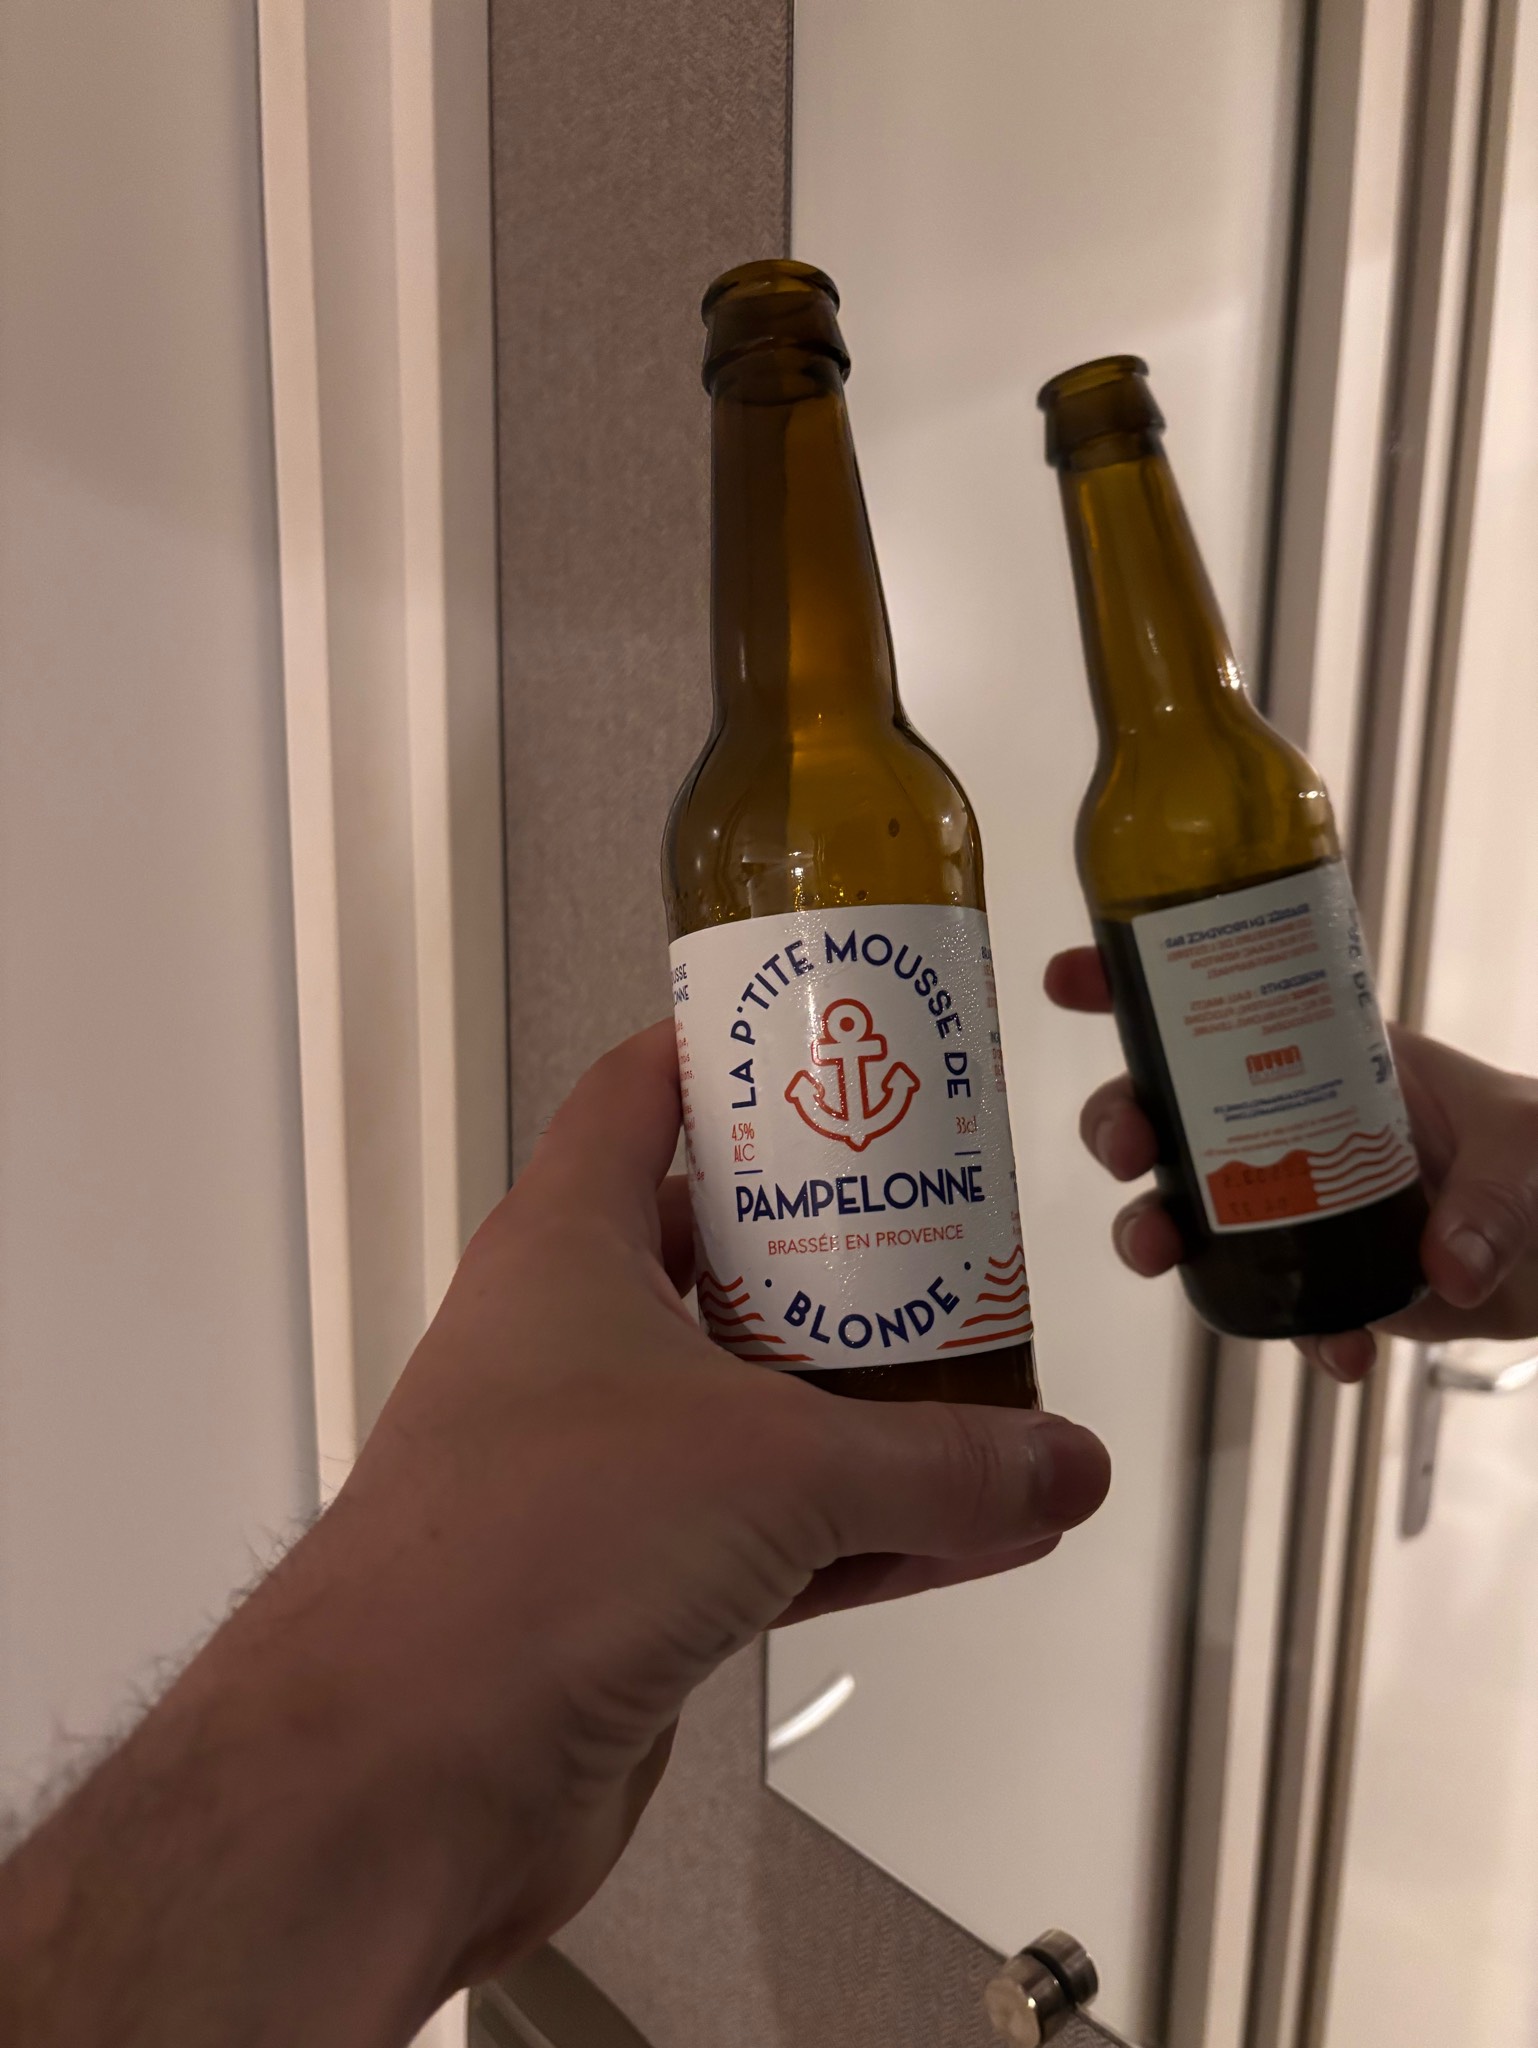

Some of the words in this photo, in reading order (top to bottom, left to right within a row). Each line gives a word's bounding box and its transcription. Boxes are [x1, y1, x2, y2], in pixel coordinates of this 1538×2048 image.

[730, 940, 814, 1045] P'TITE
[824, 929, 963, 1039] MOUSSE
[729, 1058, 757, 1109] LA
[943, 1051, 971, 1099] DE
[735, 1165, 985, 1222] PAMPELONNE
[767, 1233, 840, 1256] BRASSÉE
[845, 1234, 870, 1250] EN
[876, 1223, 965, 1248] PROVENCE
[783, 1276, 961, 1349] BLONDE
